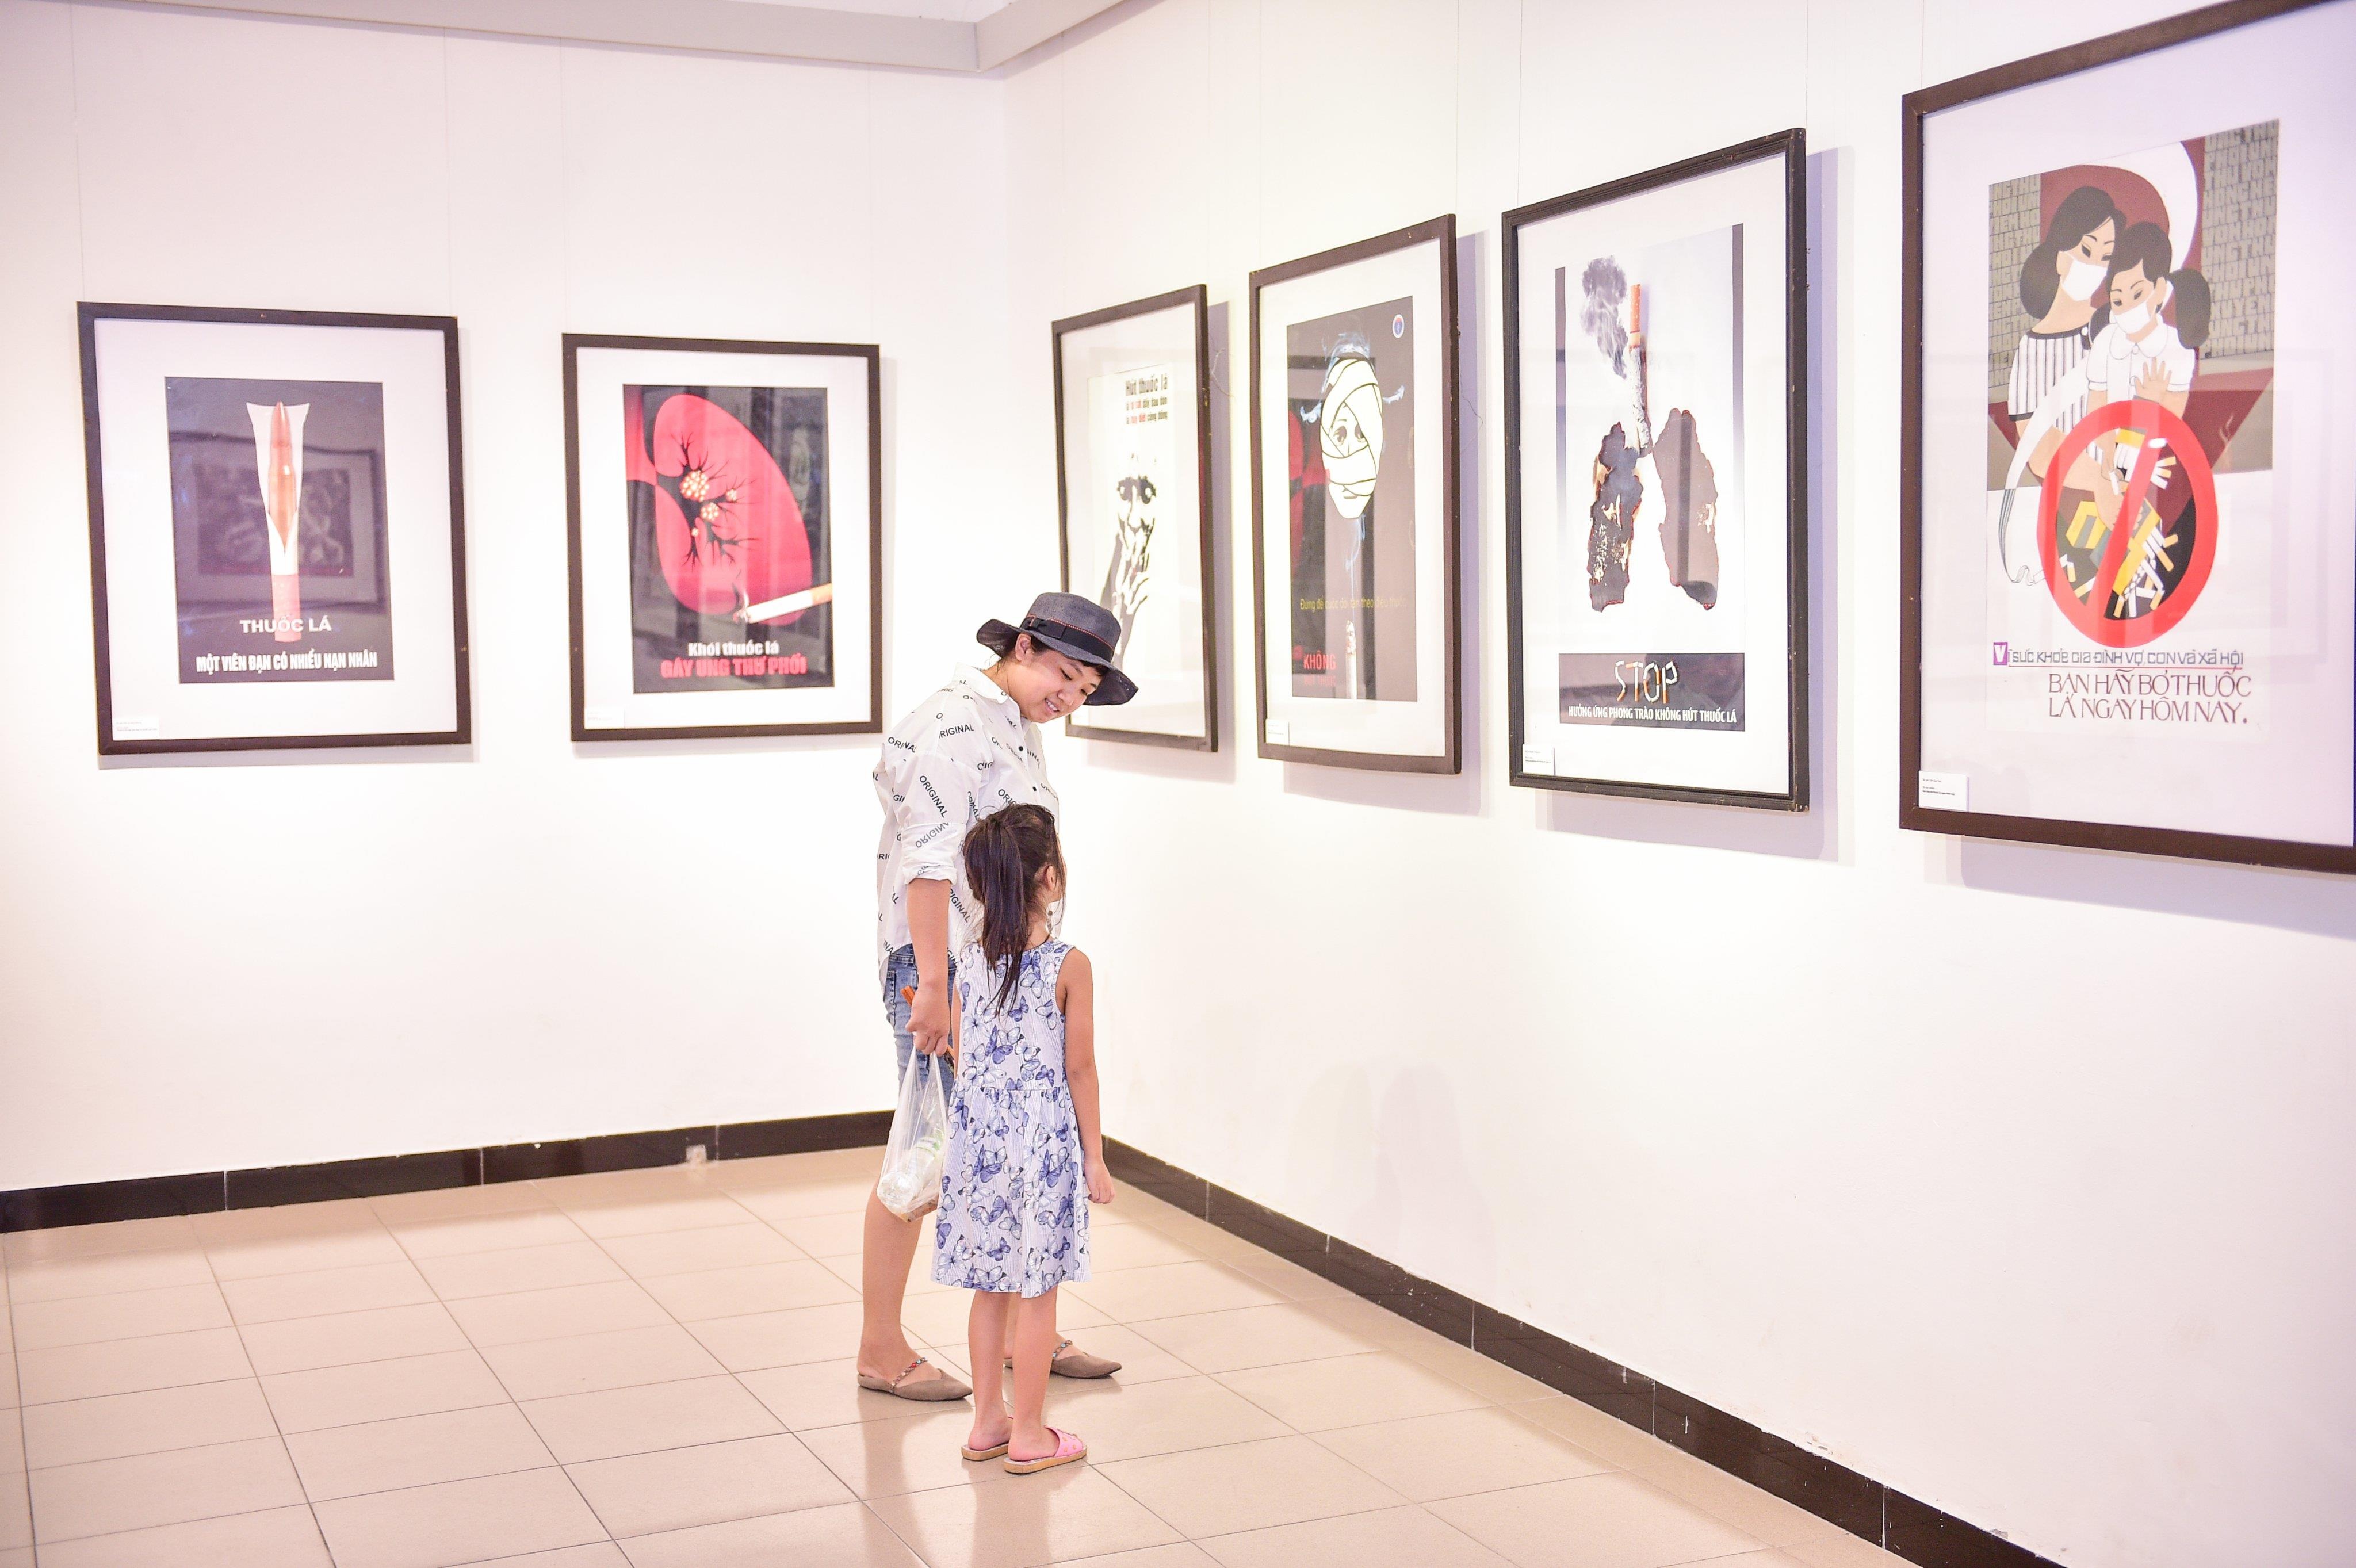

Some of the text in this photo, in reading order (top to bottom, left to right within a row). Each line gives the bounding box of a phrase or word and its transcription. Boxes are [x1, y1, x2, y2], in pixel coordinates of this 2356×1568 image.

[239, 614, 332, 633] THUỐC LÁ
[722, 639, 764, 656] thuốc
[765, 640, 779, 655] lá
[2013, 648, 2034, 663] SỨC
[2093, 649, 2122, 664] ĐÌNH
[2147, 652, 2175, 664] CON
[196, 653, 220, 675] MỘT
[221, 652, 247, 671] VIÊN
[248, 654, 271, 674] ĐẠN
[273, 651, 288, 670] CÓ
[323, 652, 346, 672] NẠN
[348, 649, 377, 668] NHÂN
[661, 657, 693, 678] GÂY
[696, 658, 731, 677] UNG
[732, 656, 767, 676] THƯ
[1303, 650, 1336, 670] KHÔNG
[1615, 660, 1678, 704] STOP
[2095, 668, 2135, 695] HÃY
[2139, 669, 2170, 695] BỎ
[2170, 666, 2251, 697] THUỐC
[1593, 705, 1608, 718] ỨNG
[1609, 707, 1633, 719] PHONG
[1634, 706, 1654, 720] TRÀO
[1655, 707, 1681, 721] KHÔNG
[1682, 707, 1698, 722] HÚT
[1699, 707, 1725, 722] THUỐC
[1727, 709, 1737, 723] LÁ
[2082, 698, 2136, 720] NGAY
[2140, 696, 2189, 721] HÔM
[938, 724, 974, 739] RIGINAL
[919, 775, 948, 818] ORIGINAL
